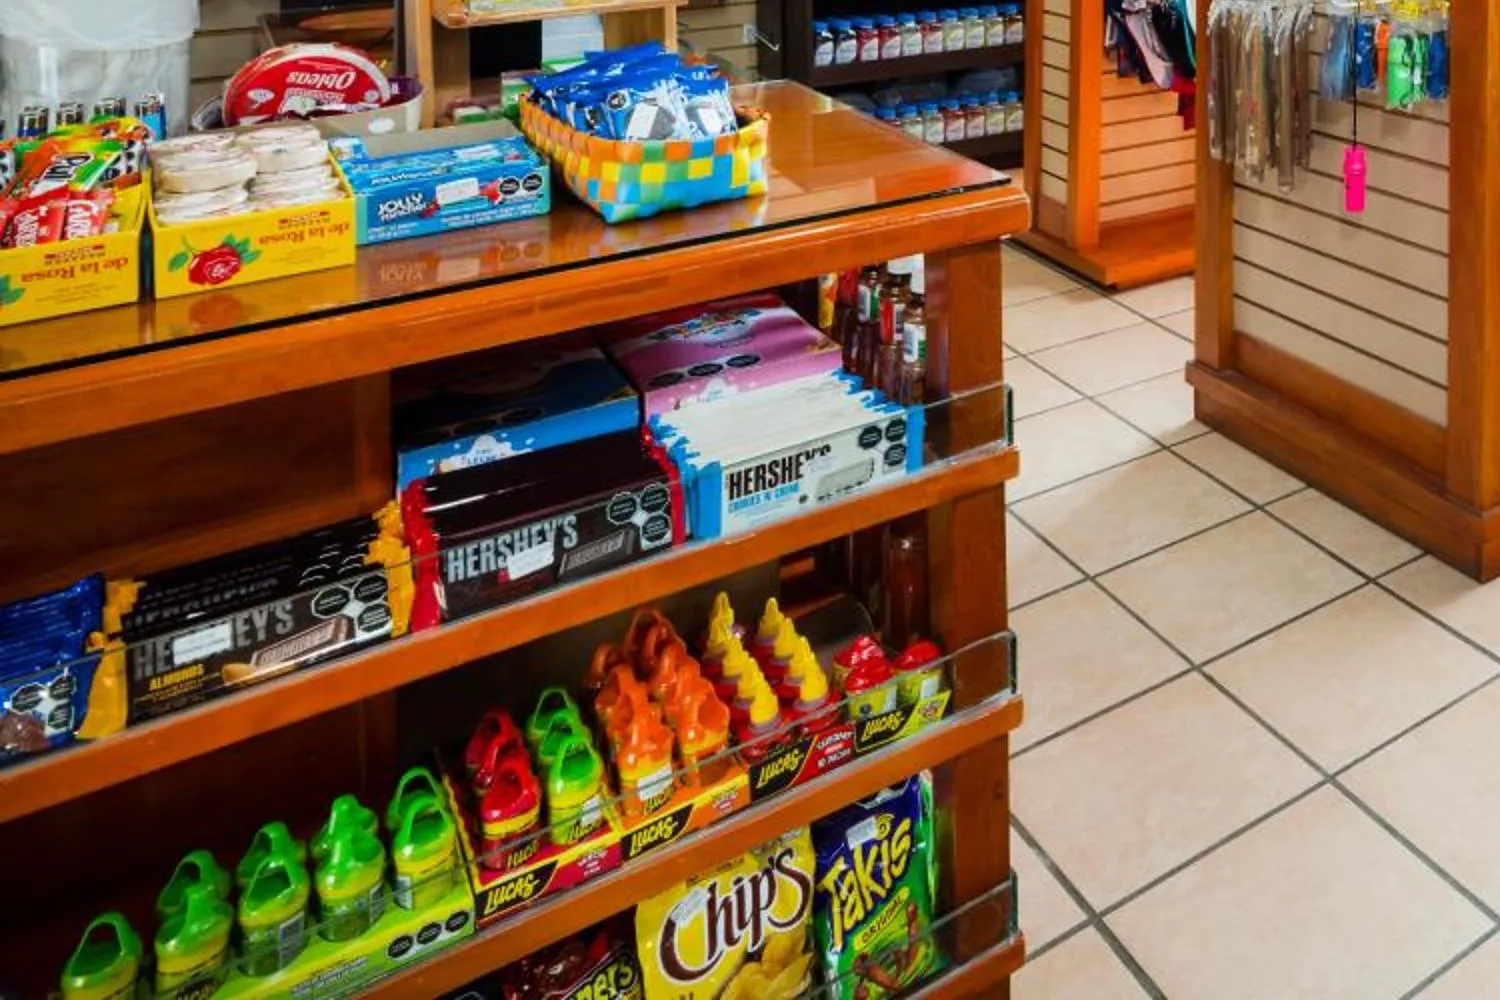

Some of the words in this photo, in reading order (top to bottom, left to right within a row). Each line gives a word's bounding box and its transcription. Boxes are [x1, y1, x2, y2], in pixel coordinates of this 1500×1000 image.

[286, 70, 357, 90] Obleas
[378, 192, 423, 216] JOLLY
[259, 230, 306, 245] Rosa
[308, 225, 326, 238] la
[328, 222, 350, 237] de
[20, 263, 76, 284] Rosa
[80, 261, 99, 275] la
[98, 256, 129, 271] de
[446, 514, 578, 584] HERSHEY'S
[133, 598, 295, 681] HEEY'S
[861, 710, 905, 743] LUCAS
[756, 748, 805, 790] LUCAS
[629, 815, 679, 857] LUCAS
[484, 873, 541, 916] LUCAS
